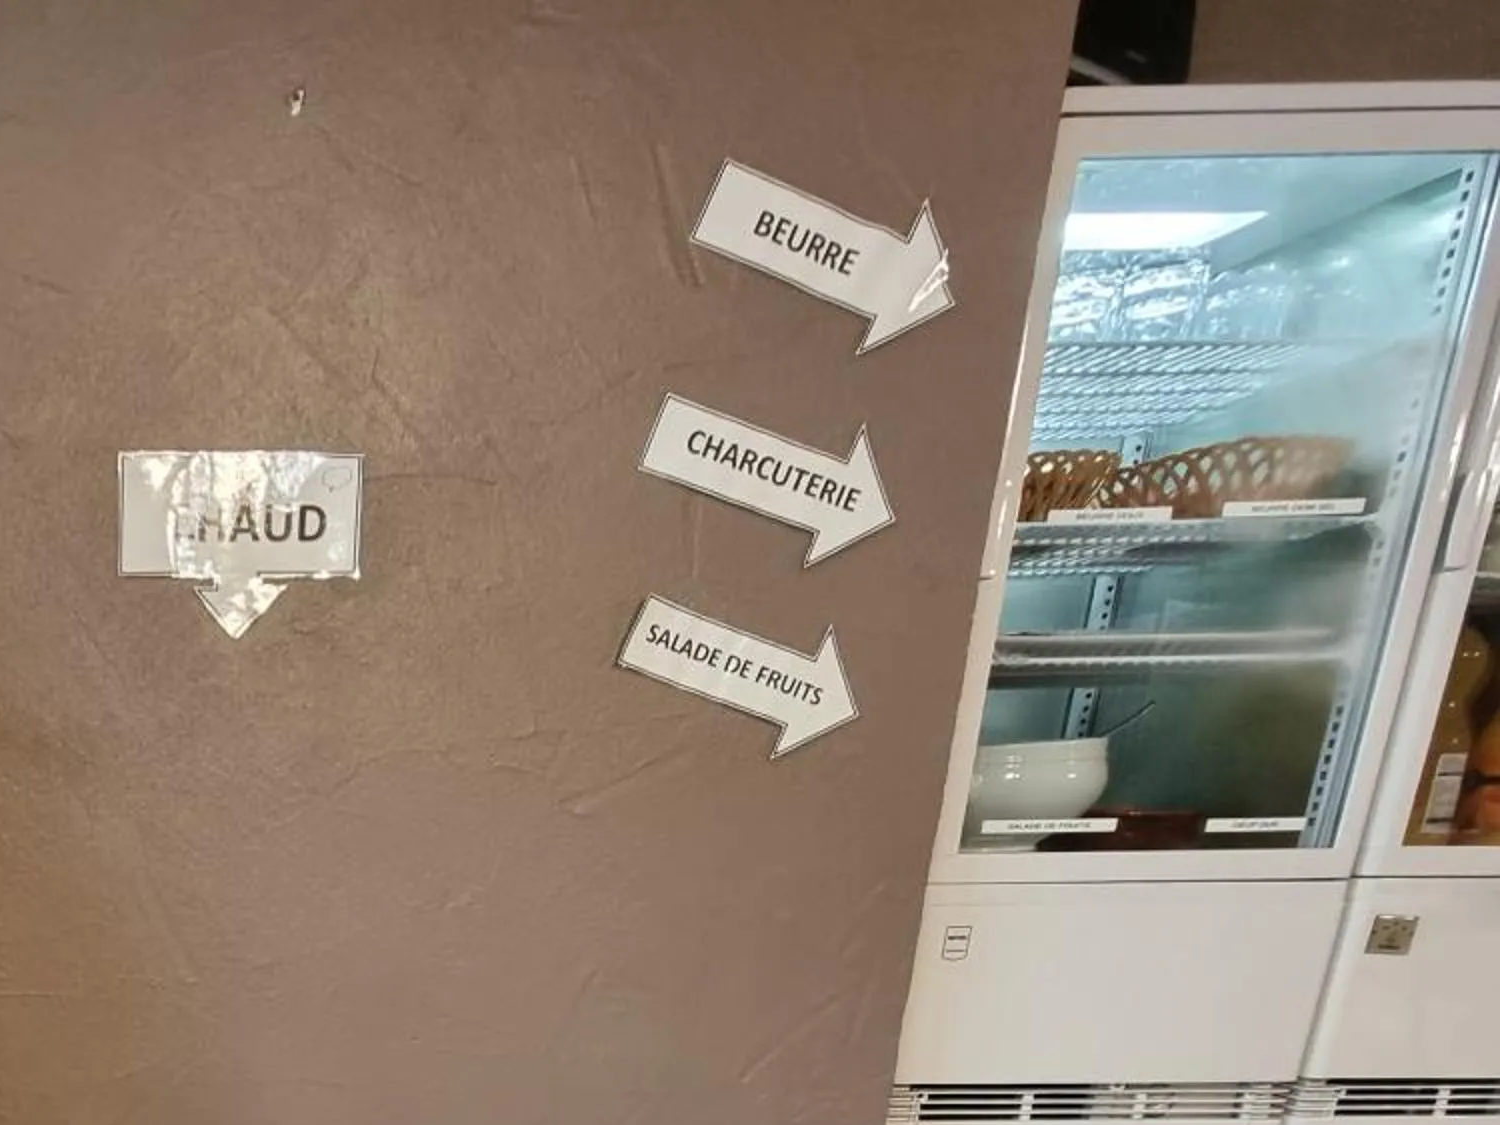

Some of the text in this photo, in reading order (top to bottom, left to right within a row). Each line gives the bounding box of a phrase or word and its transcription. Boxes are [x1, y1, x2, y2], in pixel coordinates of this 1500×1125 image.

[753, 209, 861, 277] BEURRE
[686, 429, 863, 514] CHARCUTERIE
[175, 503, 327, 542] HAUD
[646, 623, 824, 706] SALADE DE FRUITS
